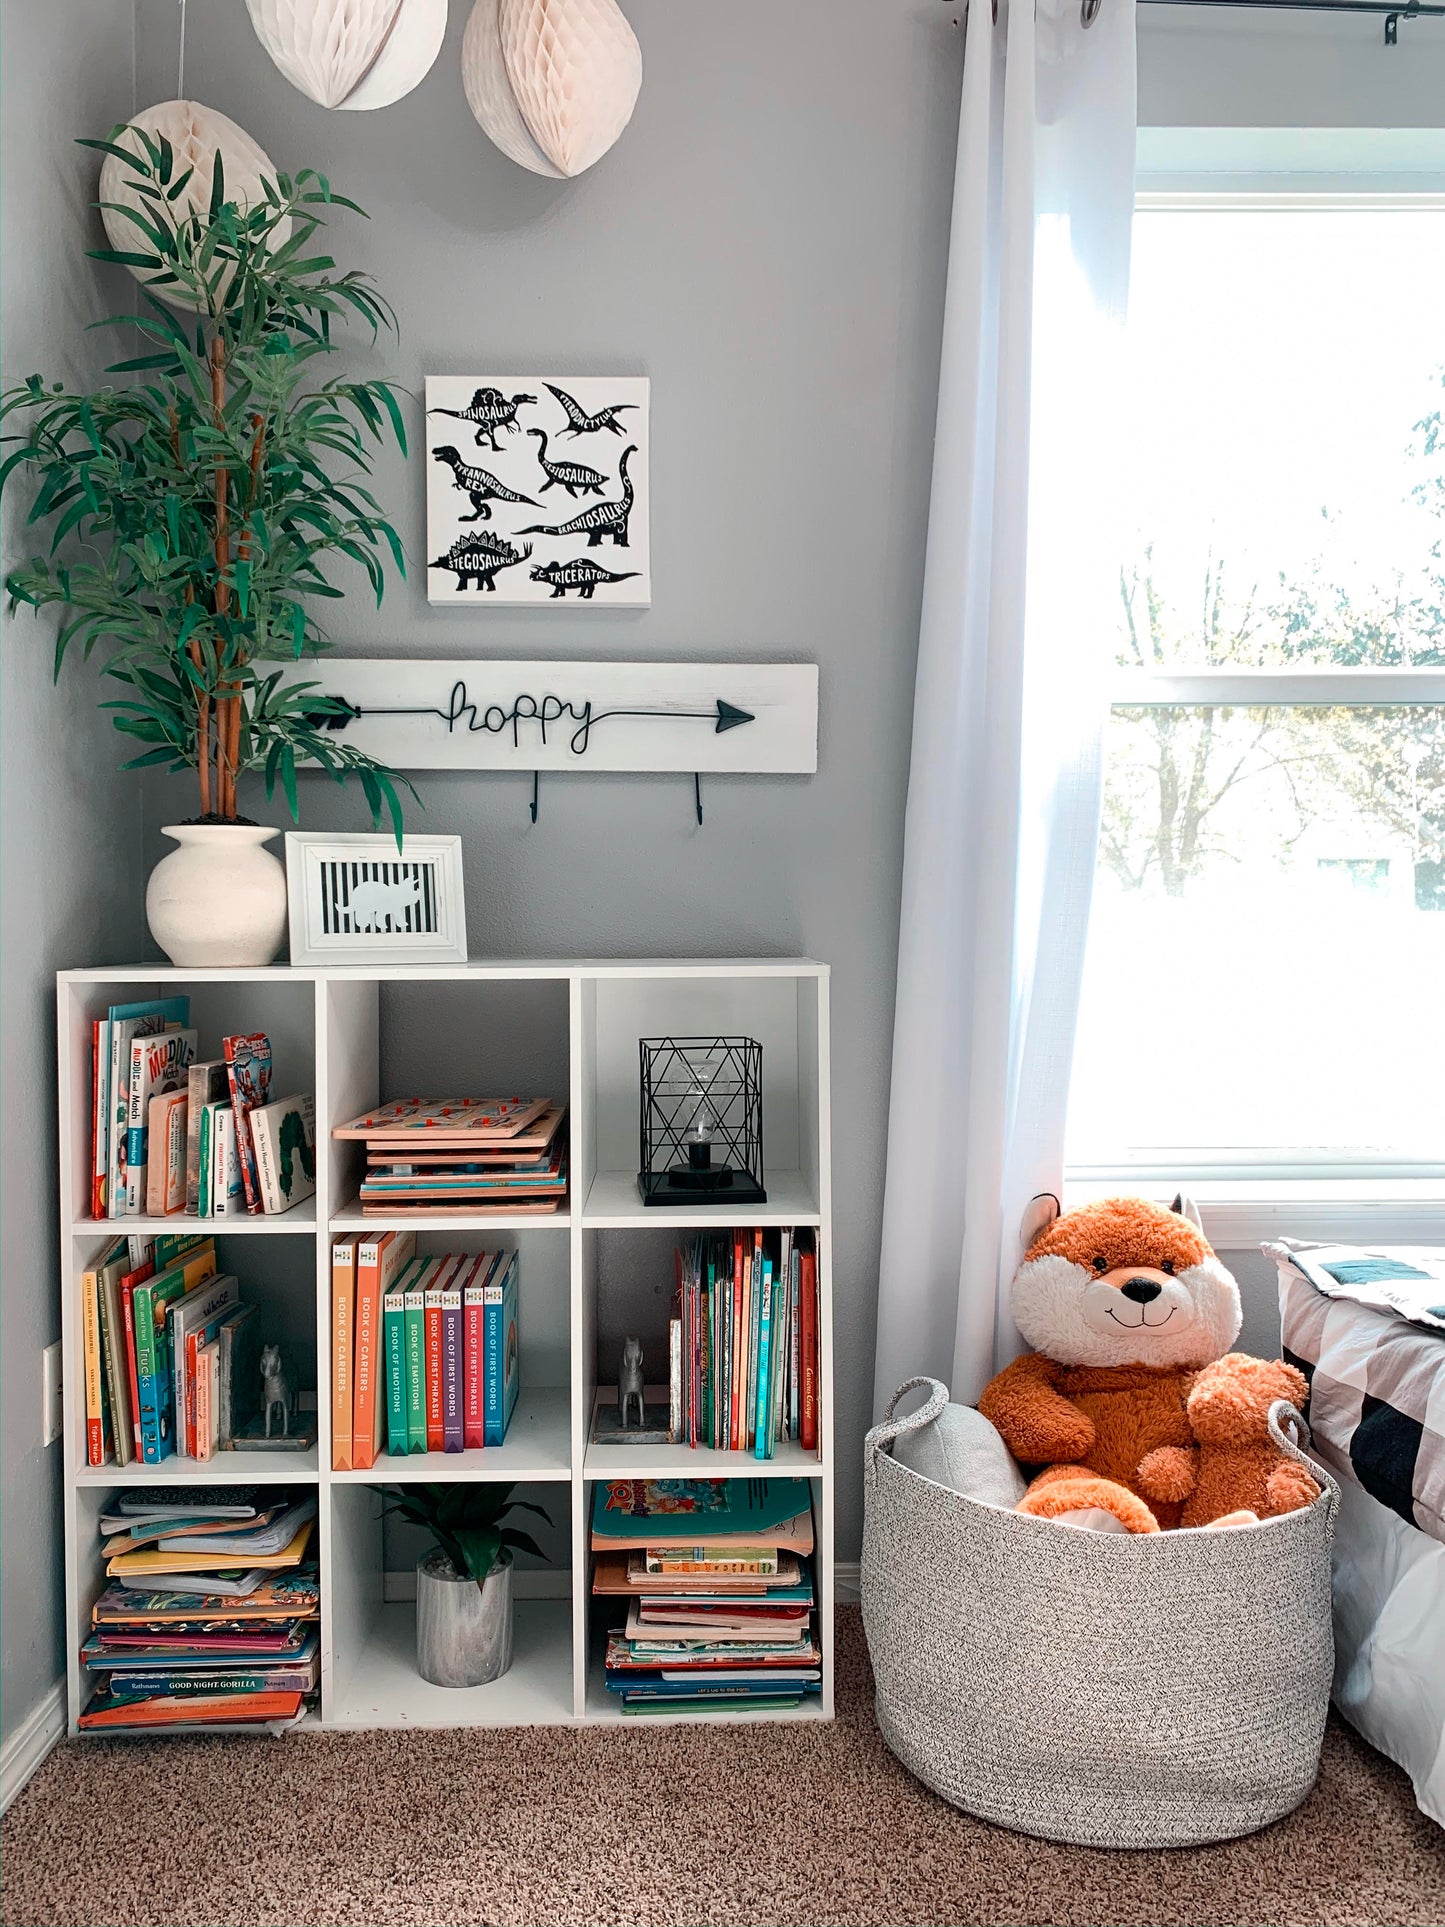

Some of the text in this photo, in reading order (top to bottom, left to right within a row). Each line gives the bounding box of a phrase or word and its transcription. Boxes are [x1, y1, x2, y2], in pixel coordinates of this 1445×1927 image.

[457, 401, 517, 421] SPINOSAURUS
[559, 393, 613, 429] PTERODACTYLUS
[453, 461, 521, 502] TYRANNOSAURUS
[542, 459, 603, 484] PLESIOSAURUS
[465, 479, 487, 494] REX
[557, 497, 631, 535] BRACHIOSAURUS
[448, 553, 515, 571] STEGOSAURUS
[549, 569, 610, 583] TRICERATOPS
[449, 681, 591, 754] happy
[132, 1048, 142, 1079] MUDDLE
[130, 1094, 141, 1120] Match
[131, 1130, 139, 1164] Adventure
[264, 1169, 272, 1190] Caterpillar
[138, 1294, 147, 1309] Slide
[338, 1297, 347, 1326] BOOK
[362, 1297, 371, 1327] BOOK
[338, 1330, 346, 1343] OF
[362, 1330, 369, 1343] OF
[430, 1313, 438, 1338] BOOK
[431, 1340, 438, 1352] OF
[448, 1344, 455, 1356] OF
[470, 1338, 477, 1349] OF
[490, 1339, 497, 1351] OF
[140, 1348, 152, 1388] Trucks
[338, 1346, 347, 1392] CAREERS
[360, 1346, 369, 1392] CAREERS
[392, 1354, 399, 1365] OF
[410, 1324, 420, 1411] BOOK OF EMOTIONS
[448, 1358, 456, 1382] FIRST
[392, 1368, 401, 1413] EMOTIONS
[806, 1368, 814, 1395] Curious
[448, 1384, 456, 1417] WORDS
[470, 1378, 478, 1416] PHRASES
[804, 1394, 814, 1420] George
[131, 1681, 161, 1690] Rathmann
[169, 1680, 191, 1690] GOOD
[220, 1678, 256, 1689] GORILLA
